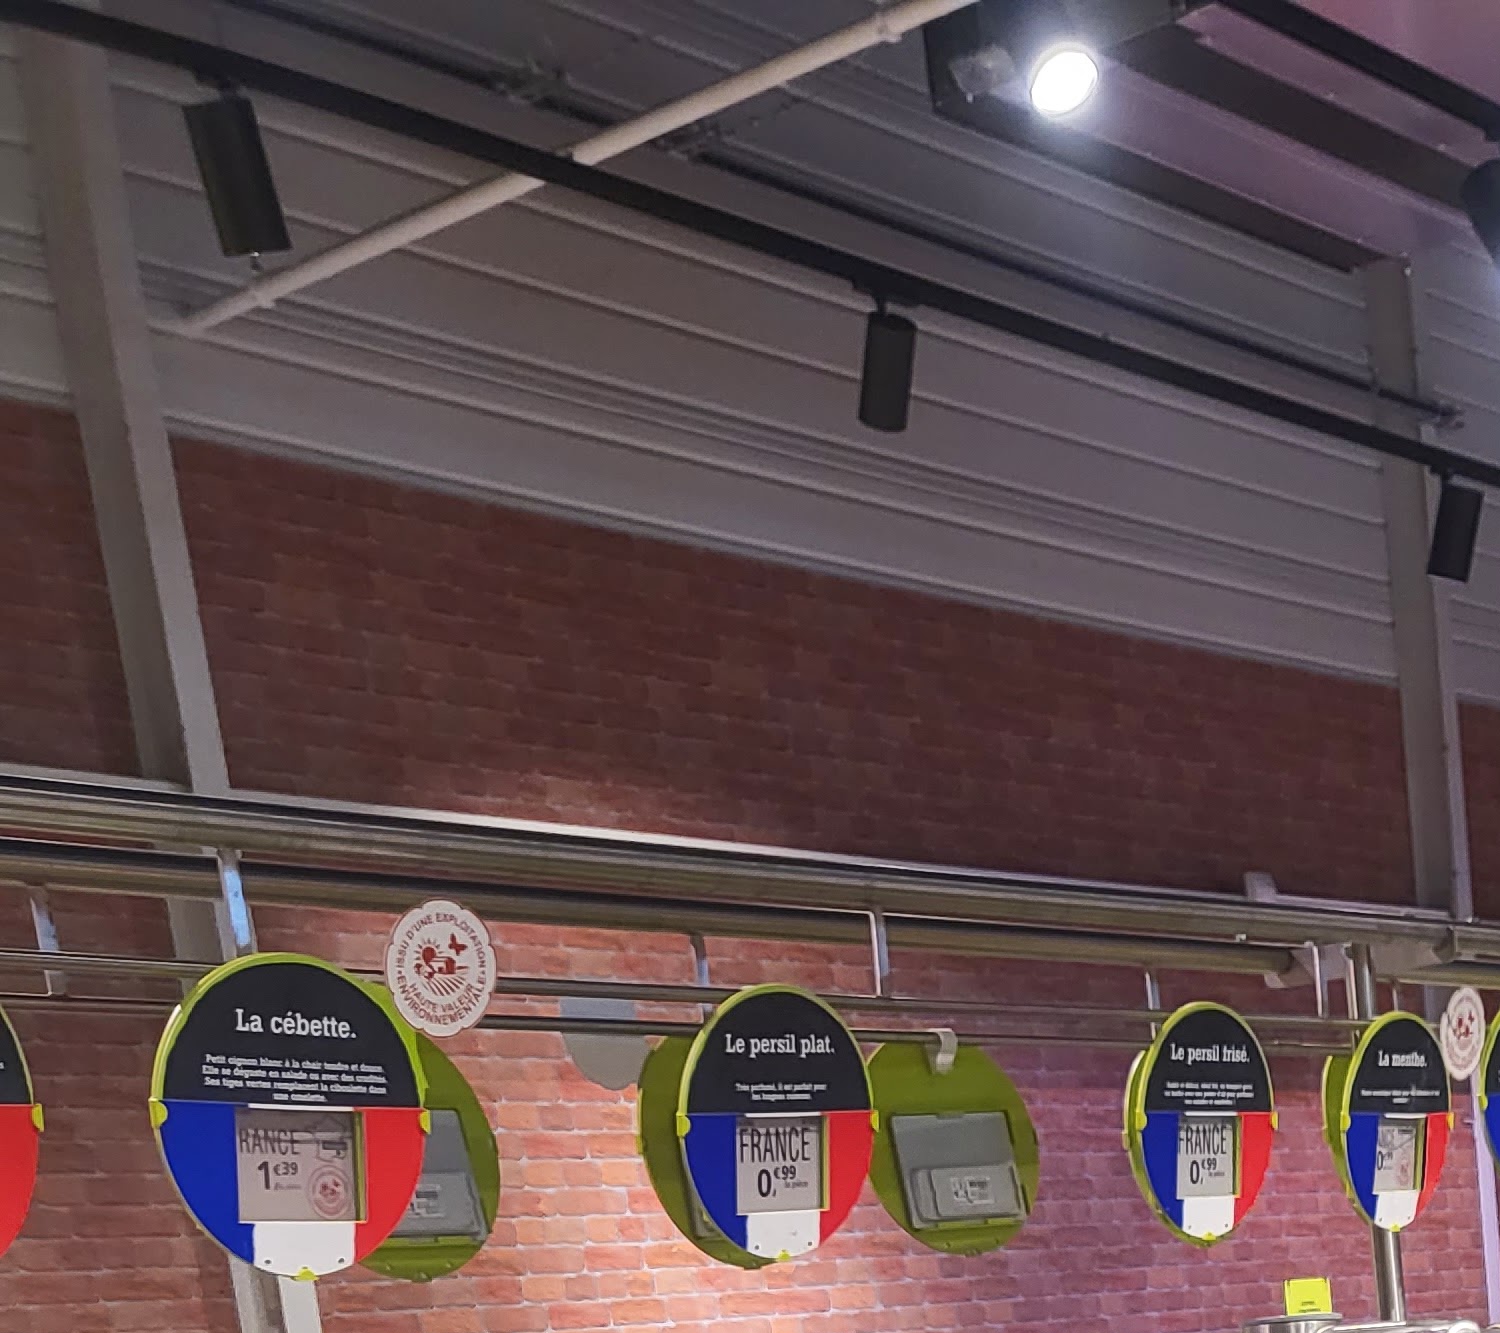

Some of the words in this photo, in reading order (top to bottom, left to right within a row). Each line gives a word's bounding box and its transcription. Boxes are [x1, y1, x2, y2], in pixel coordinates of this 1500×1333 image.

[235, 1008, 263, 1032] La
[270, 1011, 357, 1039] cébette.
[725, 1033, 745, 1053] Le
[749, 1034, 796, 1058] persil
[799, 1033, 835, 1058] plat.
[1170, 1043, 1184, 1060] Le
[1187, 1044, 1219, 1065] persil
[1378, 1050, 1389, 1067] La
[1391, 1052, 1428, 1067] menthe.
[740, 1126, 811, 1163] FRANCE
